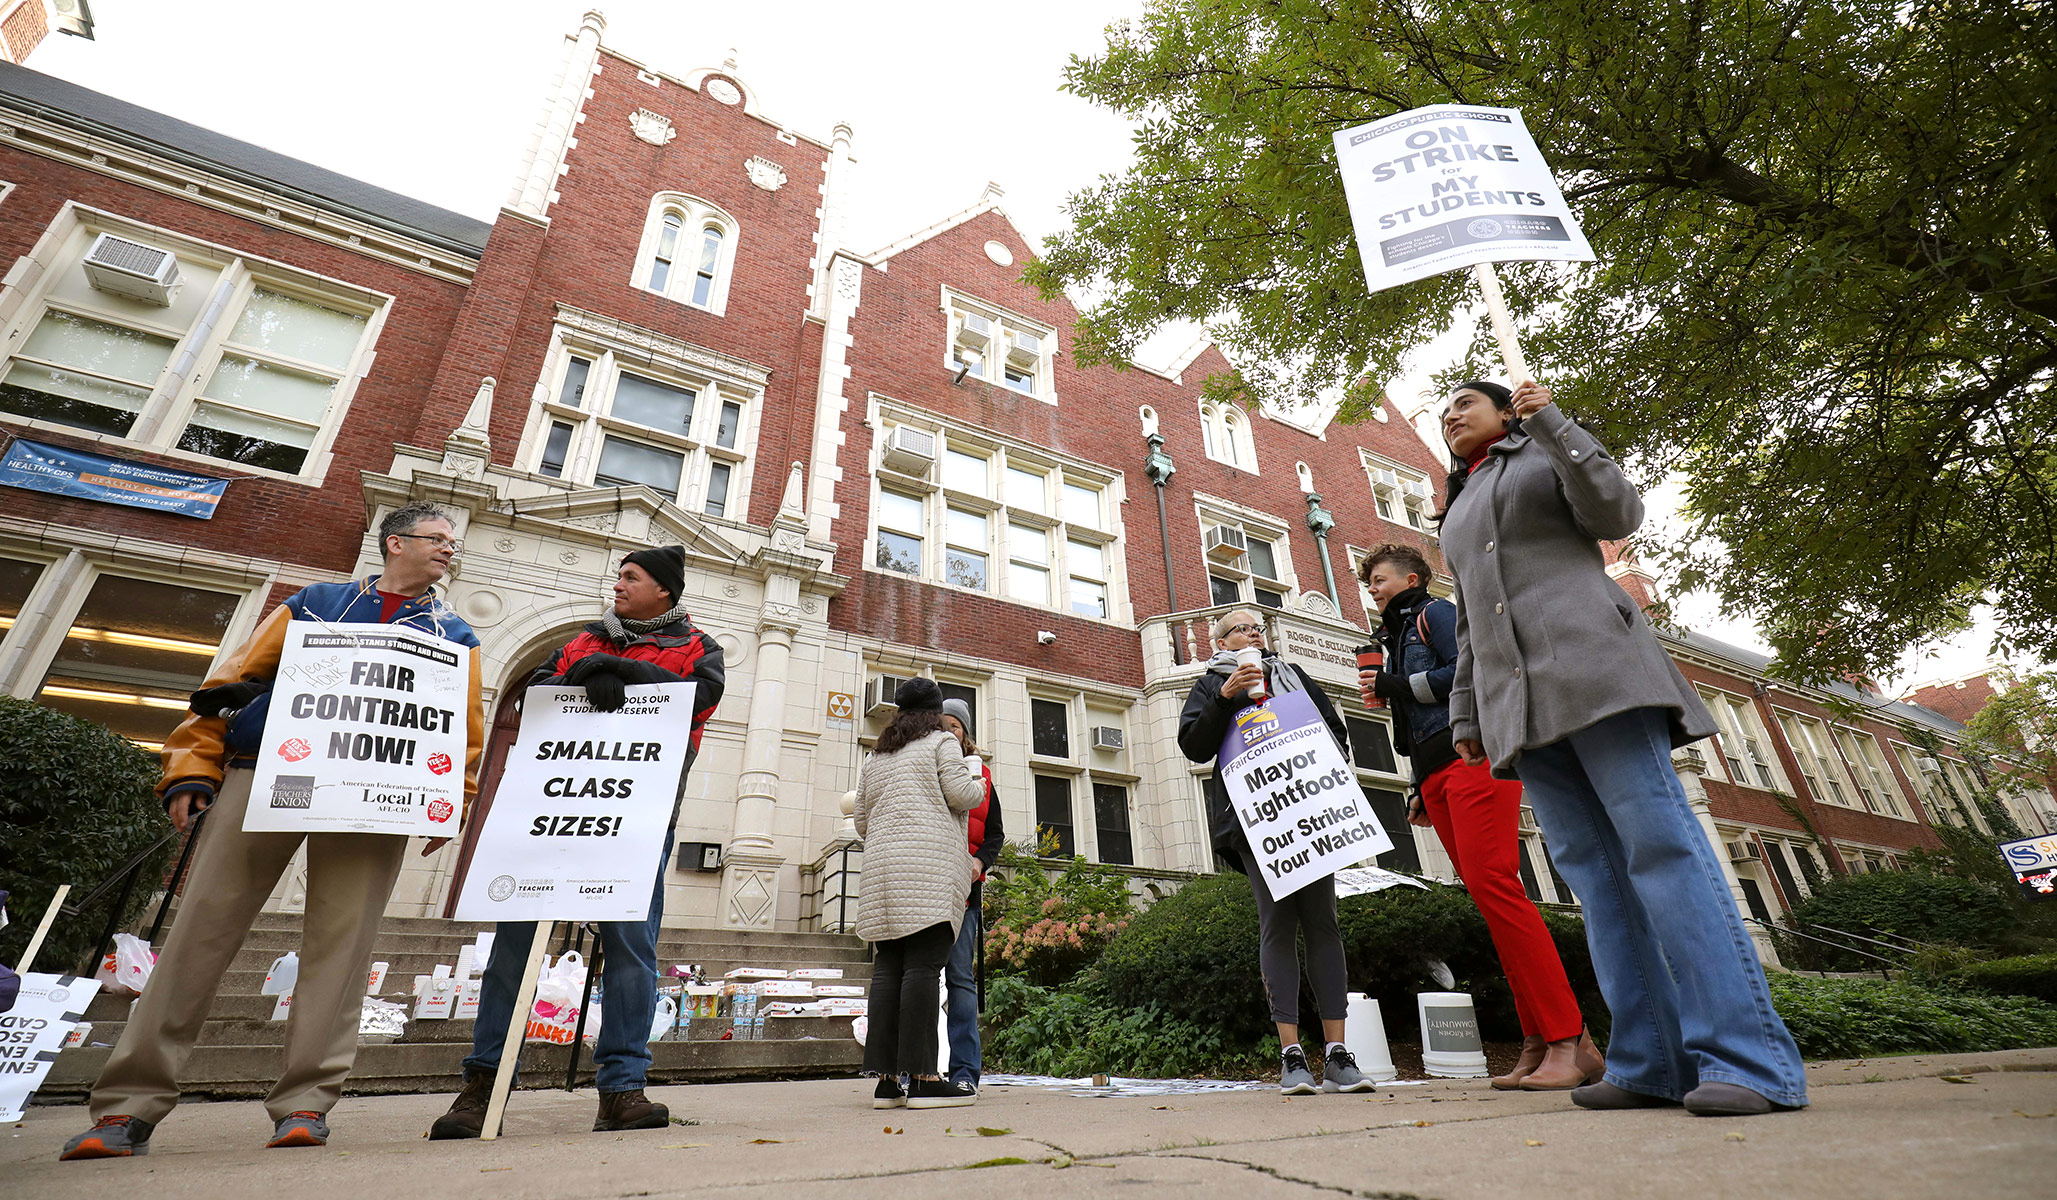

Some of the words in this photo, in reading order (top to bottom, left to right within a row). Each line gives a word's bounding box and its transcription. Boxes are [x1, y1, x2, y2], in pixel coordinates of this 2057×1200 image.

[1354, 120, 1408, 144] CHICAGO
[1410, 112, 1452, 125] PUBLIC
[1454, 112, 1507, 122] SCHOOLS
[1405, 126, 1470, 150] ON
[1372, 144, 1519, 183] STRIKE
[1441, 166, 1462, 176] for
[1431, 175, 1479, 198] MY
[1378, 190, 1546, 230] STUDENTS
[1417, 240, 1443, 251] deserve
[108, 467, 132, 475] SNAP
[132, 471, 187, 487] ENROLLMENT
[190, 476, 209, 485] AND
[91, 476, 140, 490] HEALTHY
[144, 486, 164, 495] CPS
[167, 491, 212, 501] HOTLINE
[140, 497, 158, 505] KIDS
[1285, 630, 1316, 645] ROGER
[307, 637, 358, 646] EDUCATORS
[360, 638, 386, 647] STAND
[387, 640, 417, 653] STRONG
[417, 647, 432, 657] AND
[431, 651, 455, 663] UNITED
[1288, 643, 1320, 660] SENIOR
[1319, 651, 1341, 665] HIGH
[1341, 657, 1358, 668] SCH
[281, 654, 341, 682] Please
[305, 667, 348, 688] HONK
[350, 661, 415, 693] FAIR
[554, 694, 576, 703] FOR
[649, 695, 670, 703] OUR
[290, 693, 455, 734] CONTRACT
[616, 706, 660, 715] DESERVE
[1235, 706, 1260, 720] LOCAL
[1243, 719, 1280, 744] SEIU
[327, 731, 416, 766] NOW!
[535, 740, 662, 762] SMALLER
[1223, 724, 1322, 779] #FairContractNow
[1243, 748, 1317, 794] Mayor
[273, 790, 312, 798] TEACHERS
[340, 780, 375, 788] American
[376, 782, 412, 791] Federation
[422, 786, 449, 794] Teachers
[362, 788, 412, 805] Local
[419, 793, 426, 806] 1
[543, 777, 634, 799] CLASS
[1241, 767, 1350, 829] Lightfoot:
[272, 797, 311, 807] UNION
[377, 805, 411, 814] AFL-CIO
[529, 815, 623, 837] SIZES!
[1262, 828, 1296, 855] Our
[1296, 798, 1360, 837] Strike/
[1266, 848, 1311, 880] Your
[1310, 821, 1378, 857] Watch
[579, 885, 606, 894] Local
[607, 885, 614, 893] 1
[0, 1016, 48, 1030] CAD
